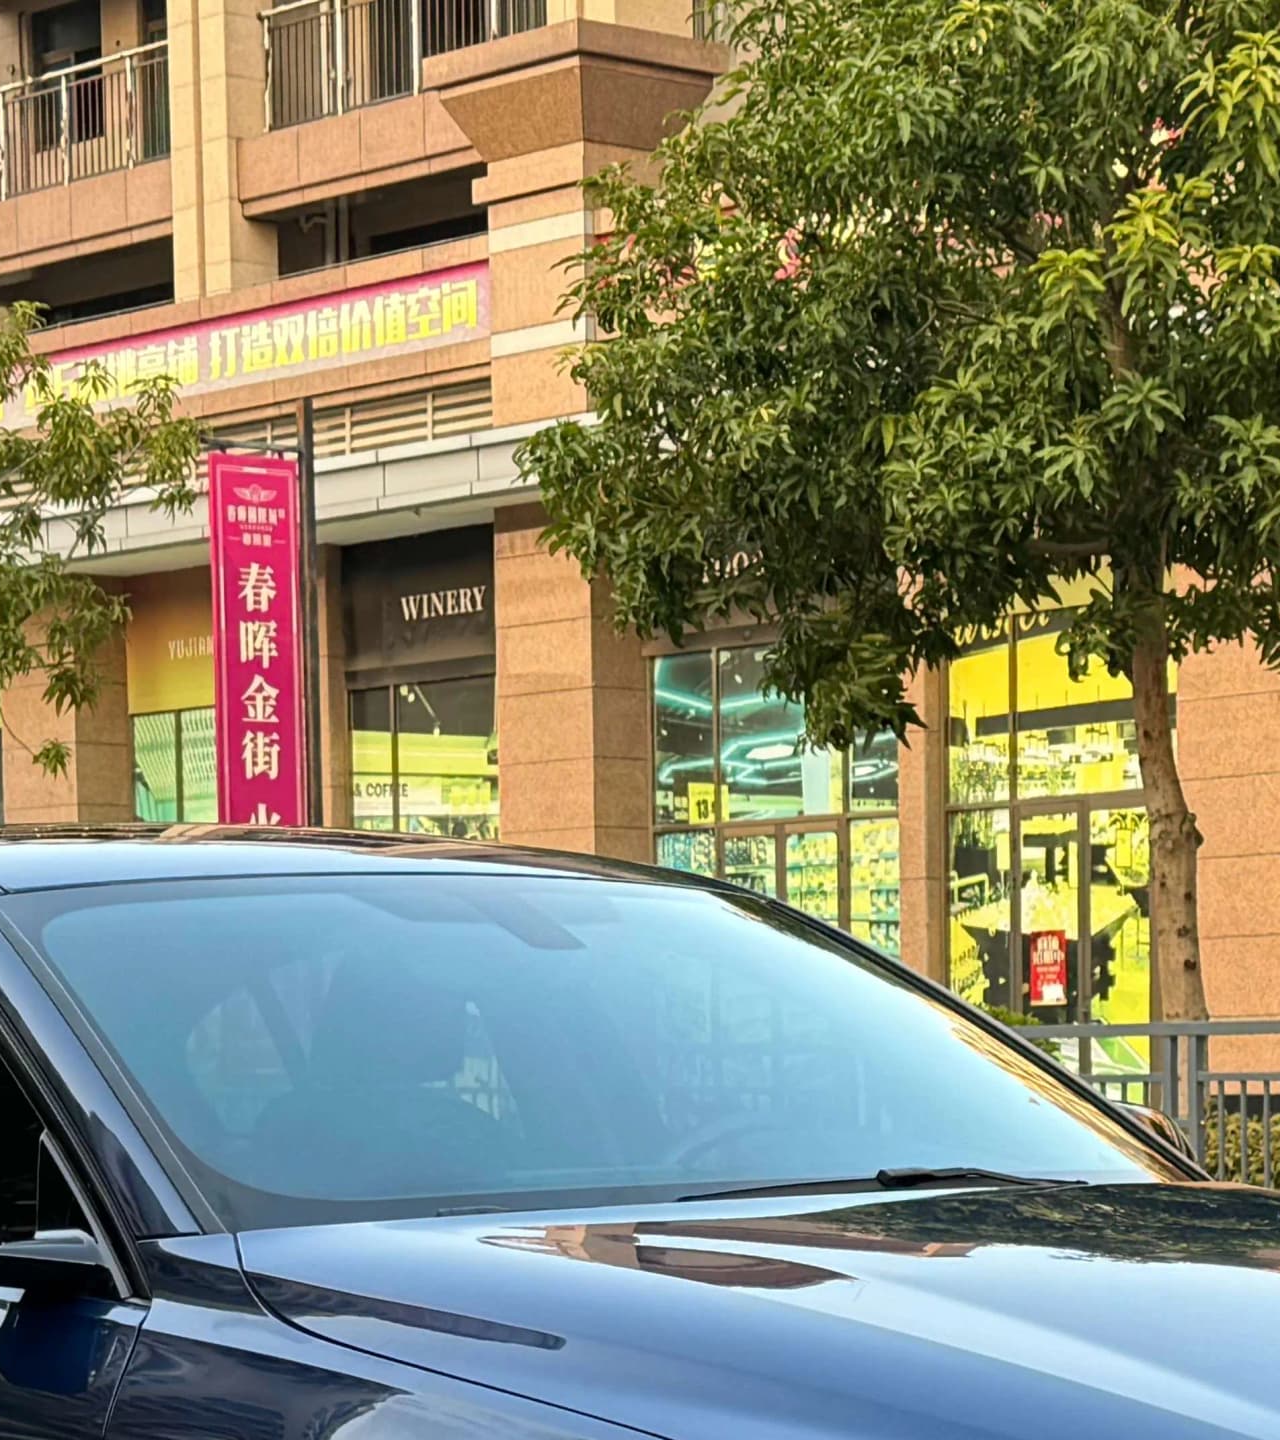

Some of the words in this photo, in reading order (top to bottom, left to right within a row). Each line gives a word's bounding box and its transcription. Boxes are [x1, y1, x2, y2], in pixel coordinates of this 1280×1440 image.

[209, 279, 478, 381] 打造双倍价值空间
[400, 585, 486, 622] WINERY
[238, 562, 282, 781] 春晖金街
